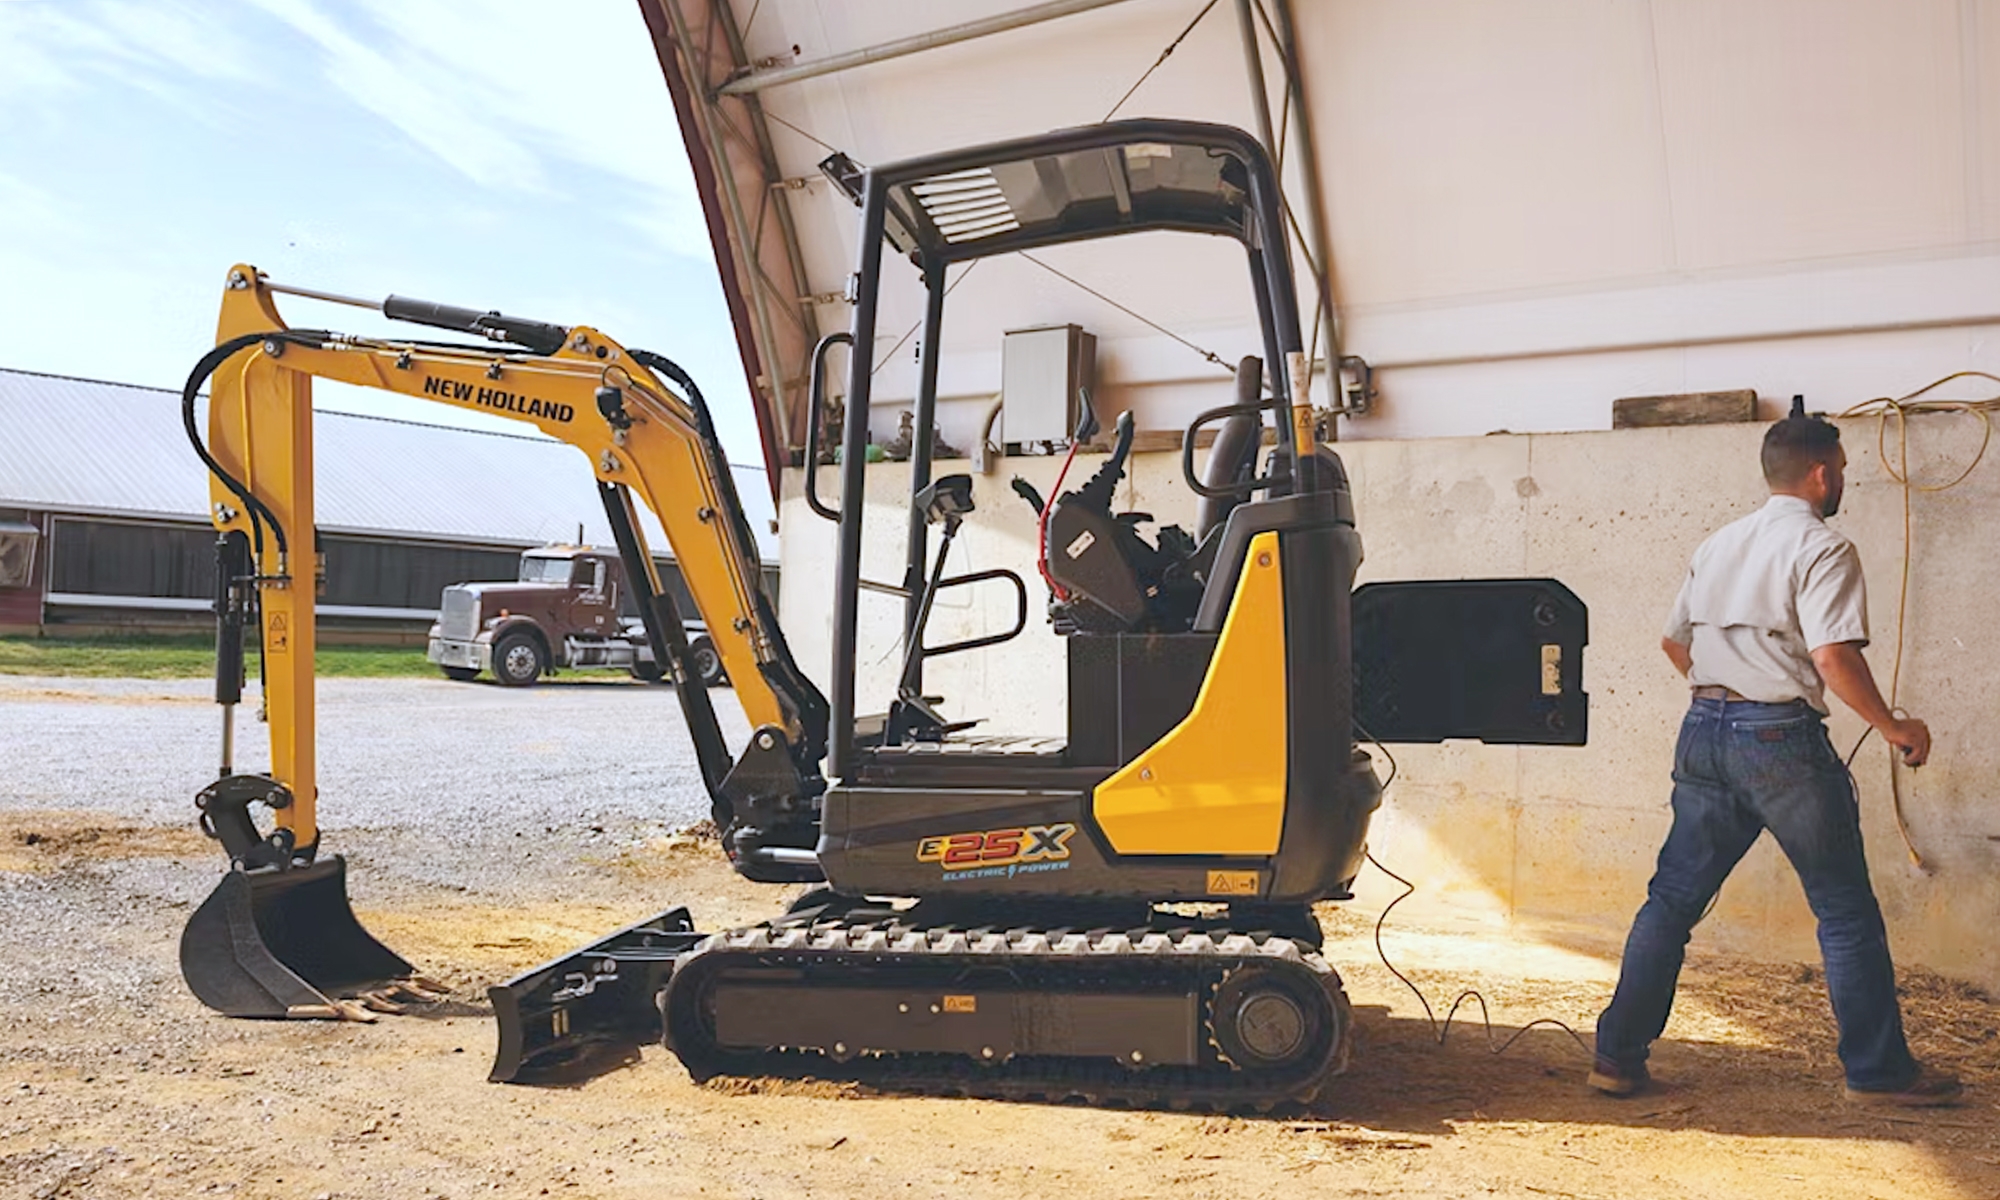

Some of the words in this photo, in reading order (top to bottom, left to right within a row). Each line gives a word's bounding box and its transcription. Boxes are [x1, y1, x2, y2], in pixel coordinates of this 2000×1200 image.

[424, 376, 474, 402] NEW
[476, 387, 574, 423] HOLLAND
[917, 823, 1076, 869] E25X
[942, 867, 1006, 881] ELECTRIC
[1018, 861, 1070, 873] POWER
